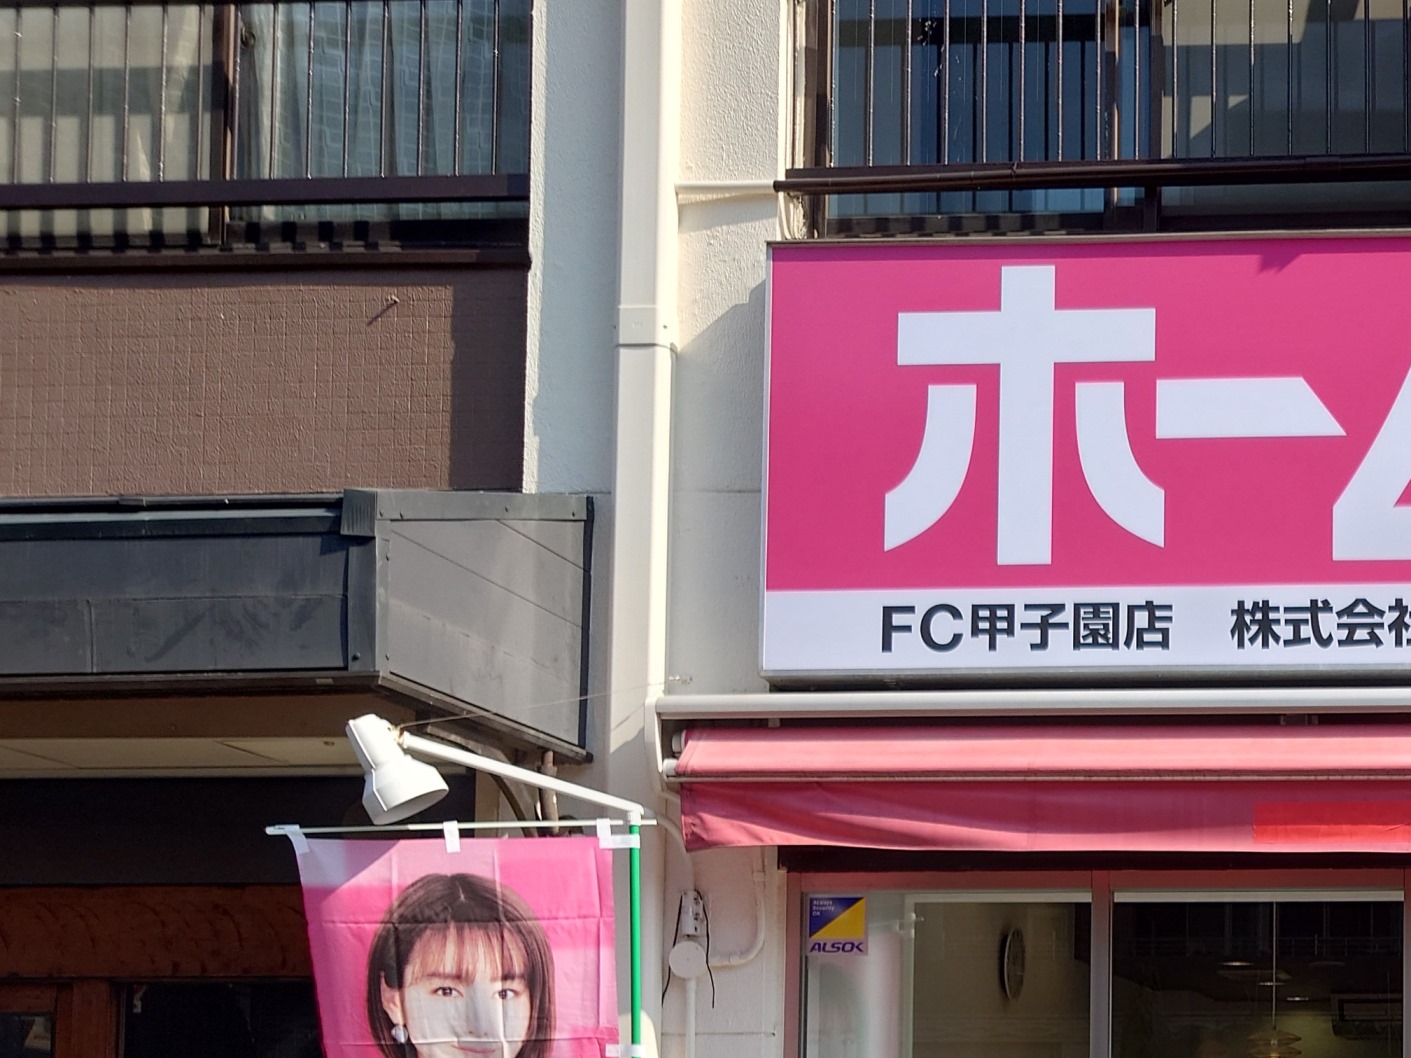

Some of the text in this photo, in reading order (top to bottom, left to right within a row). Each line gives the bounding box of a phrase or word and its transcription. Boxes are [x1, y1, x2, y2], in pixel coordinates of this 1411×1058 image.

[881, 600, 1173, 652] FC甲子園店
[810, 941, 864, 953] ALSOK
